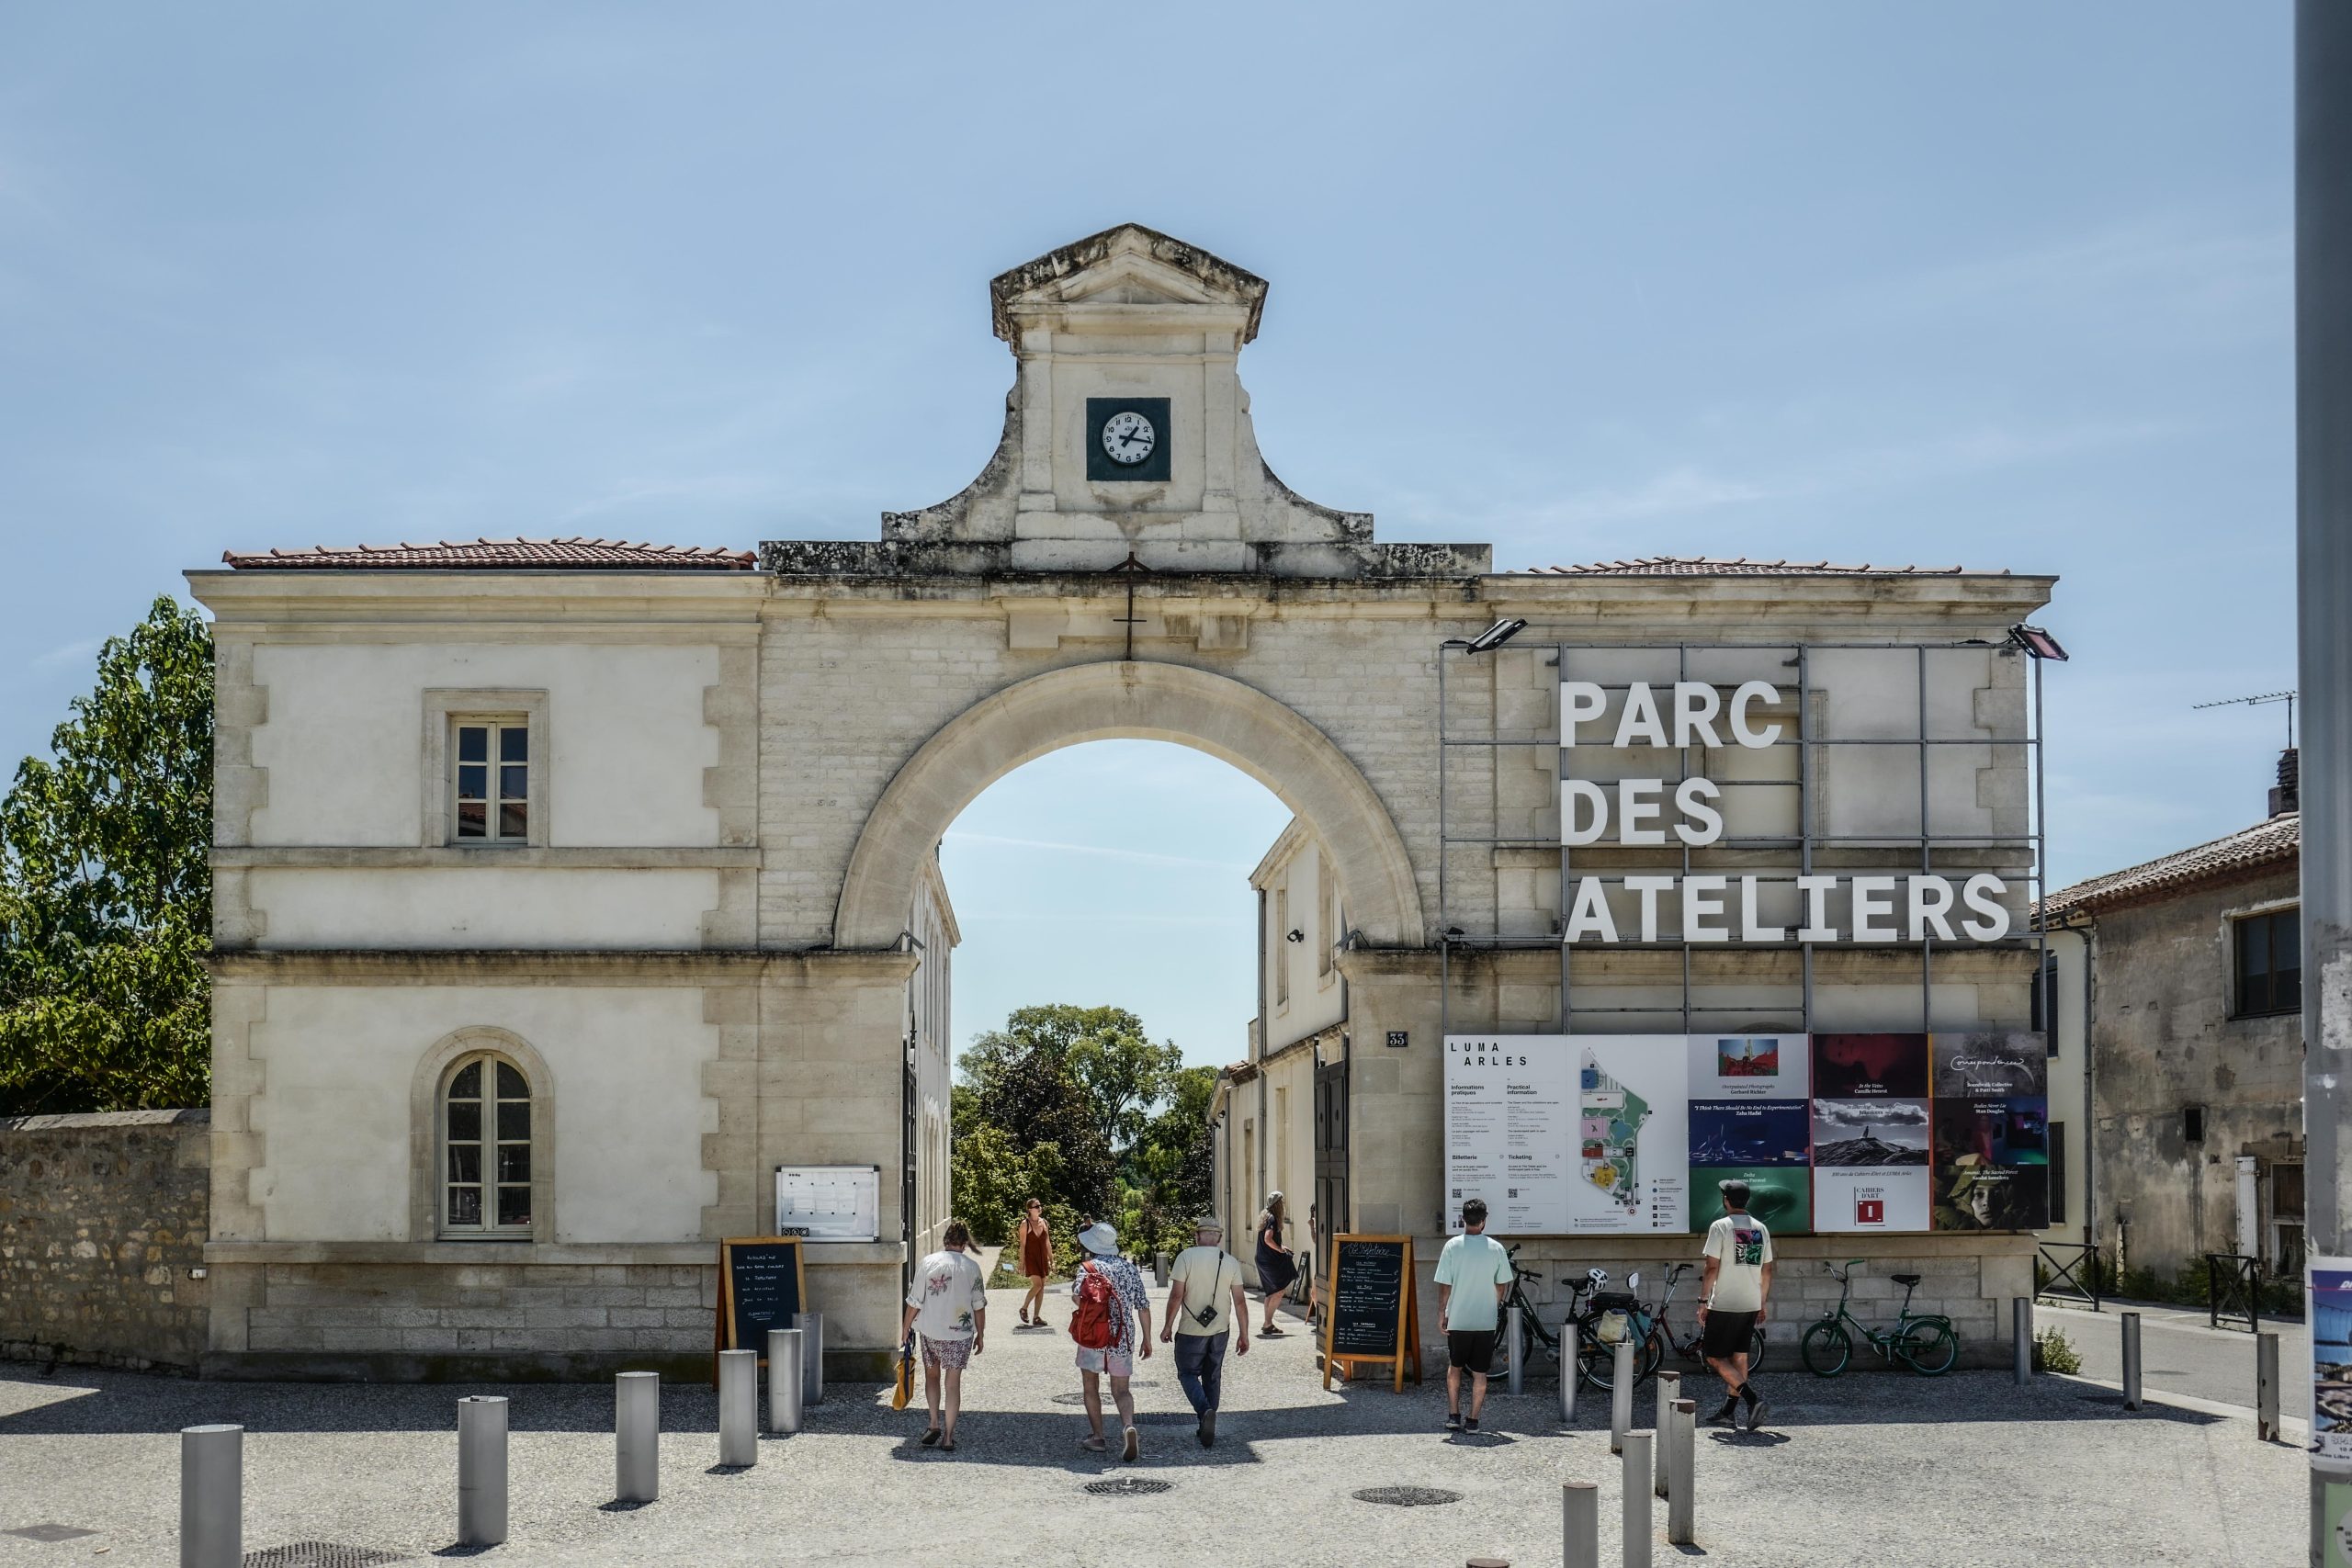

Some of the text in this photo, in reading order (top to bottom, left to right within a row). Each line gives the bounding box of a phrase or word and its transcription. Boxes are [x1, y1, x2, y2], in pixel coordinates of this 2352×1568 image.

[1560, 681, 1782, 750] PARC
[1560, 777, 1724, 846] DES
[1564, 874, 2010, 943] ATELIERS
[1389, 1033, 1405, 1045] 33
[1451, 1042, 1499, 1052] LUMA
[1464, 1056, 1527, 1066] ARLES
